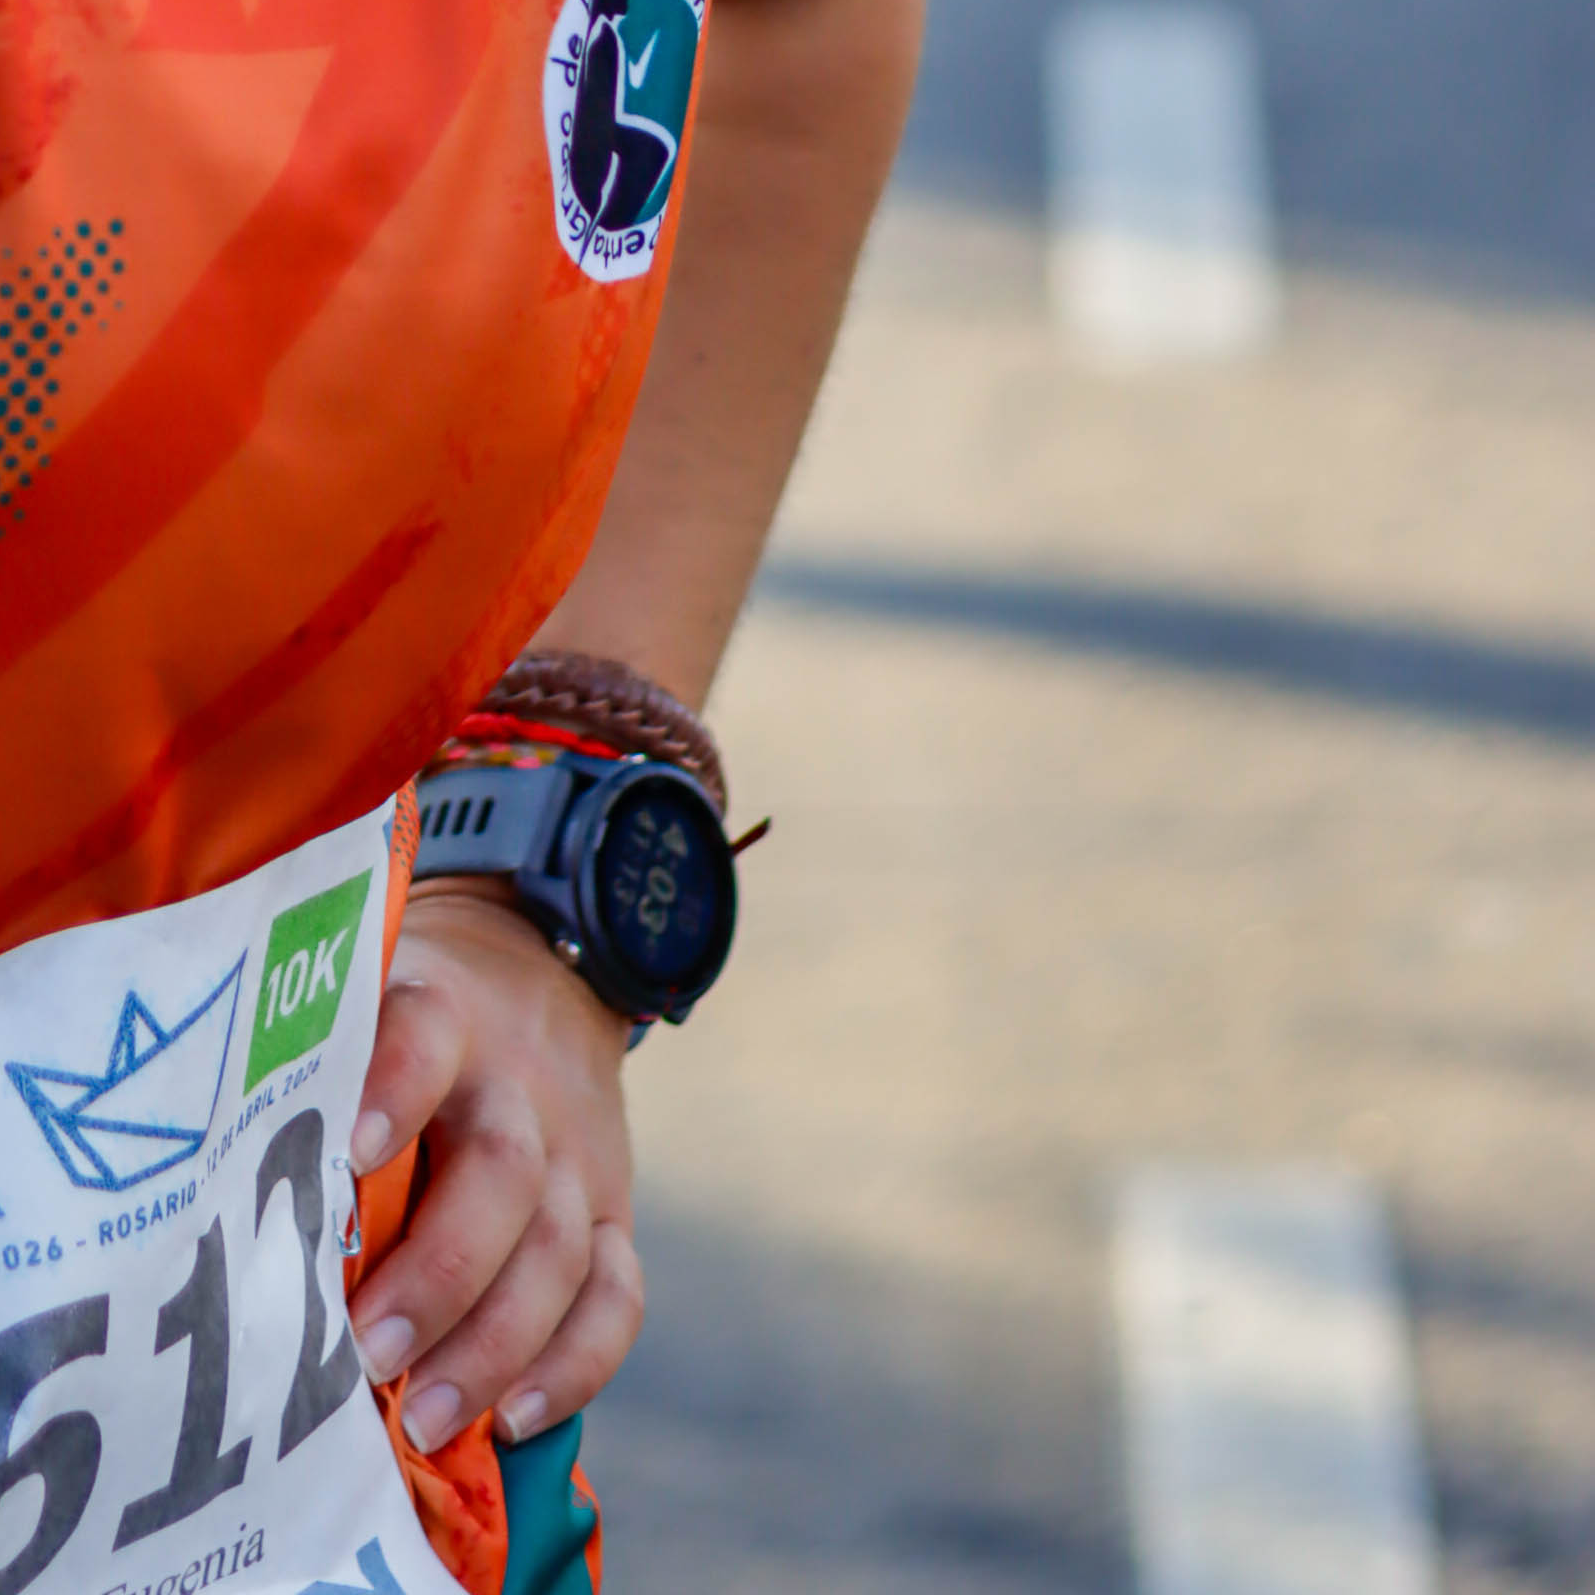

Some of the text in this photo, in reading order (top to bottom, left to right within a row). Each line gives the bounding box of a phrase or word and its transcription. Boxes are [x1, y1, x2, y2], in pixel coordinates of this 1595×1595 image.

[264, 926, 350, 1031] 10K
[99, 1179, 197, 1246] ROSARIO
[221, 1124, 234, 1160] DE
[236, 1084, 275, 1138] ABRIL
[282, 1052, 322, 1098] 2026
